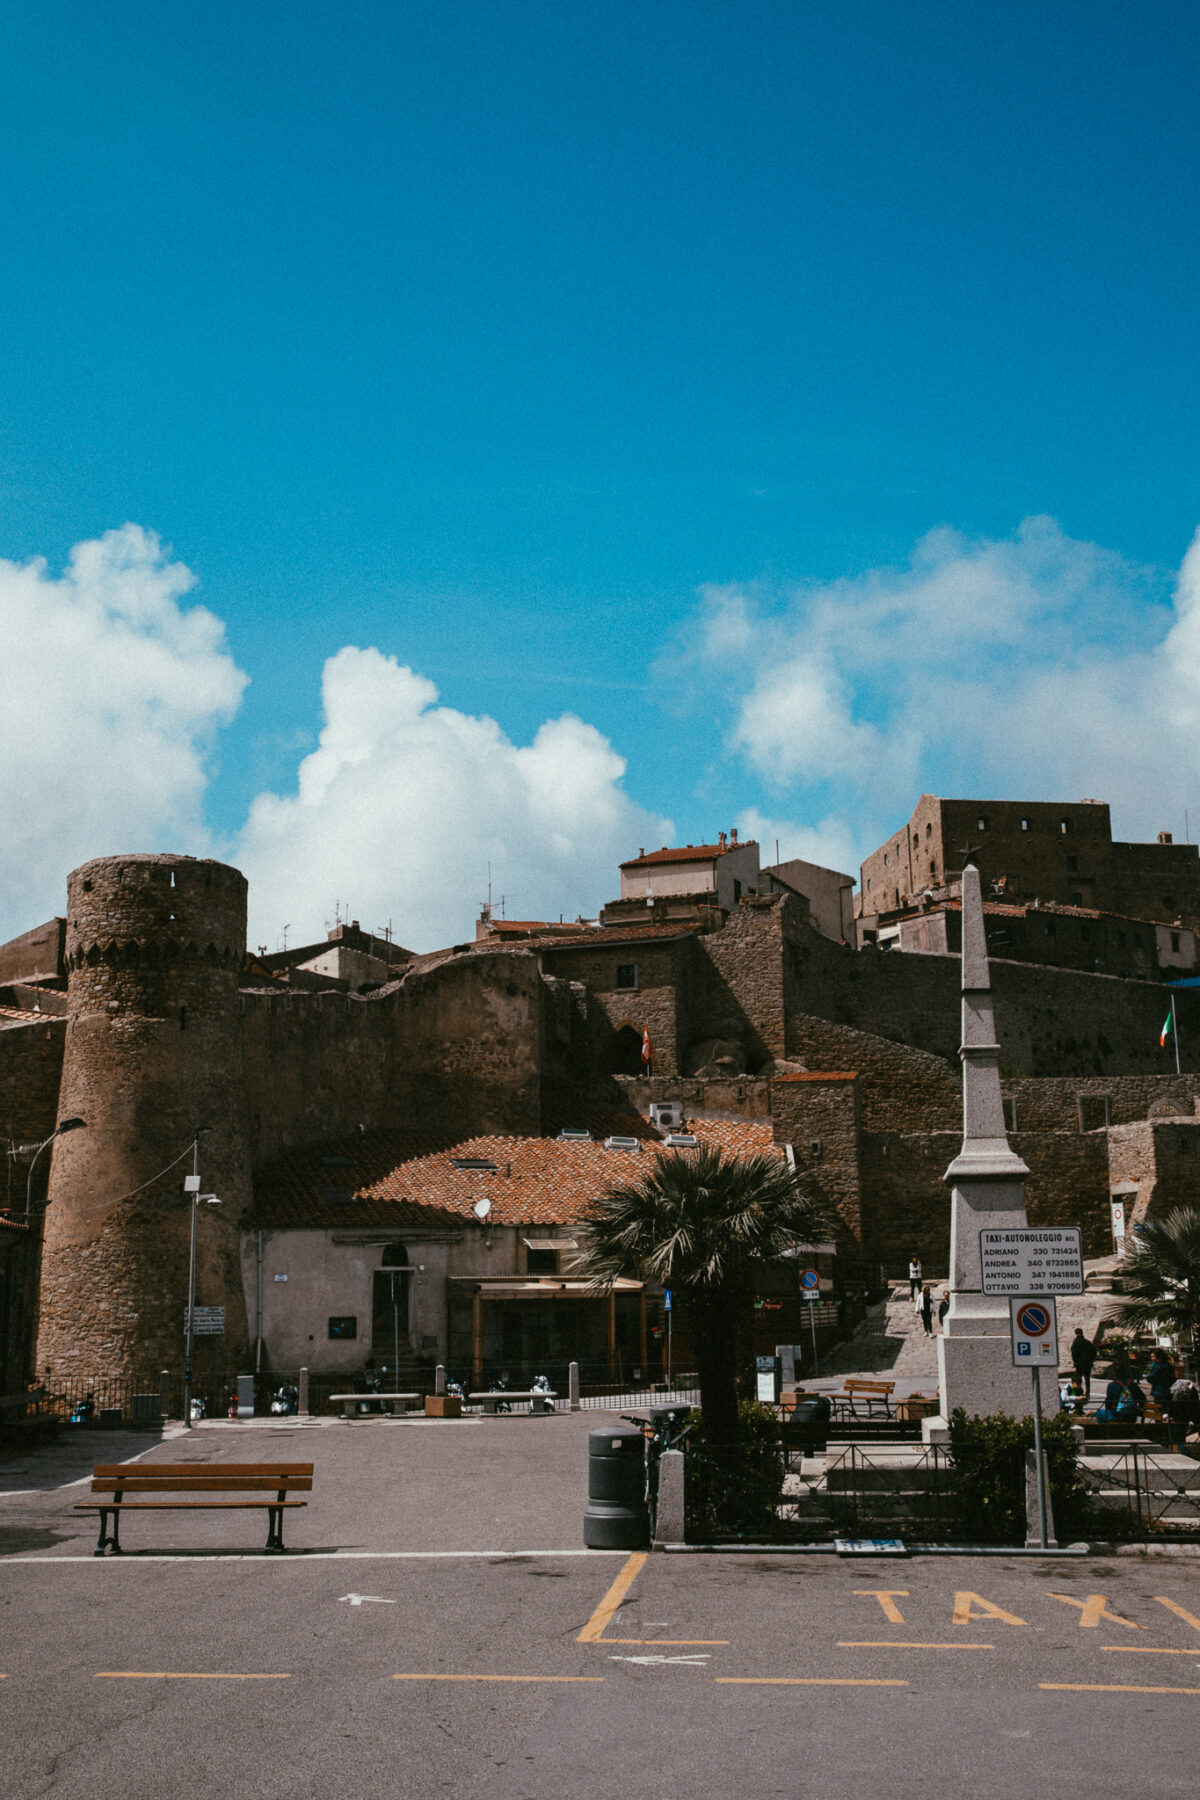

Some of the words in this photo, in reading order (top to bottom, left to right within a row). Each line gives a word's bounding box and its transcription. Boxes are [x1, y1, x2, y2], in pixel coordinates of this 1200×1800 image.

[985, 1233, 1062, 1243] TAXI-AUTONOLEGGIO
[984, 1248, 1020, 1256] ADRIANO
[1051, 1247, 1078, 1255] 731424
[984, 1260, 1017, 1268] ANDREA
[1031, 1271, 1046, 1279] 347
[985, 1283, 1020, 1291] OTTAVIO
[1047, 1282, 1081, 1290] 9706950
[1020, 1343, 1028, 1354] P
